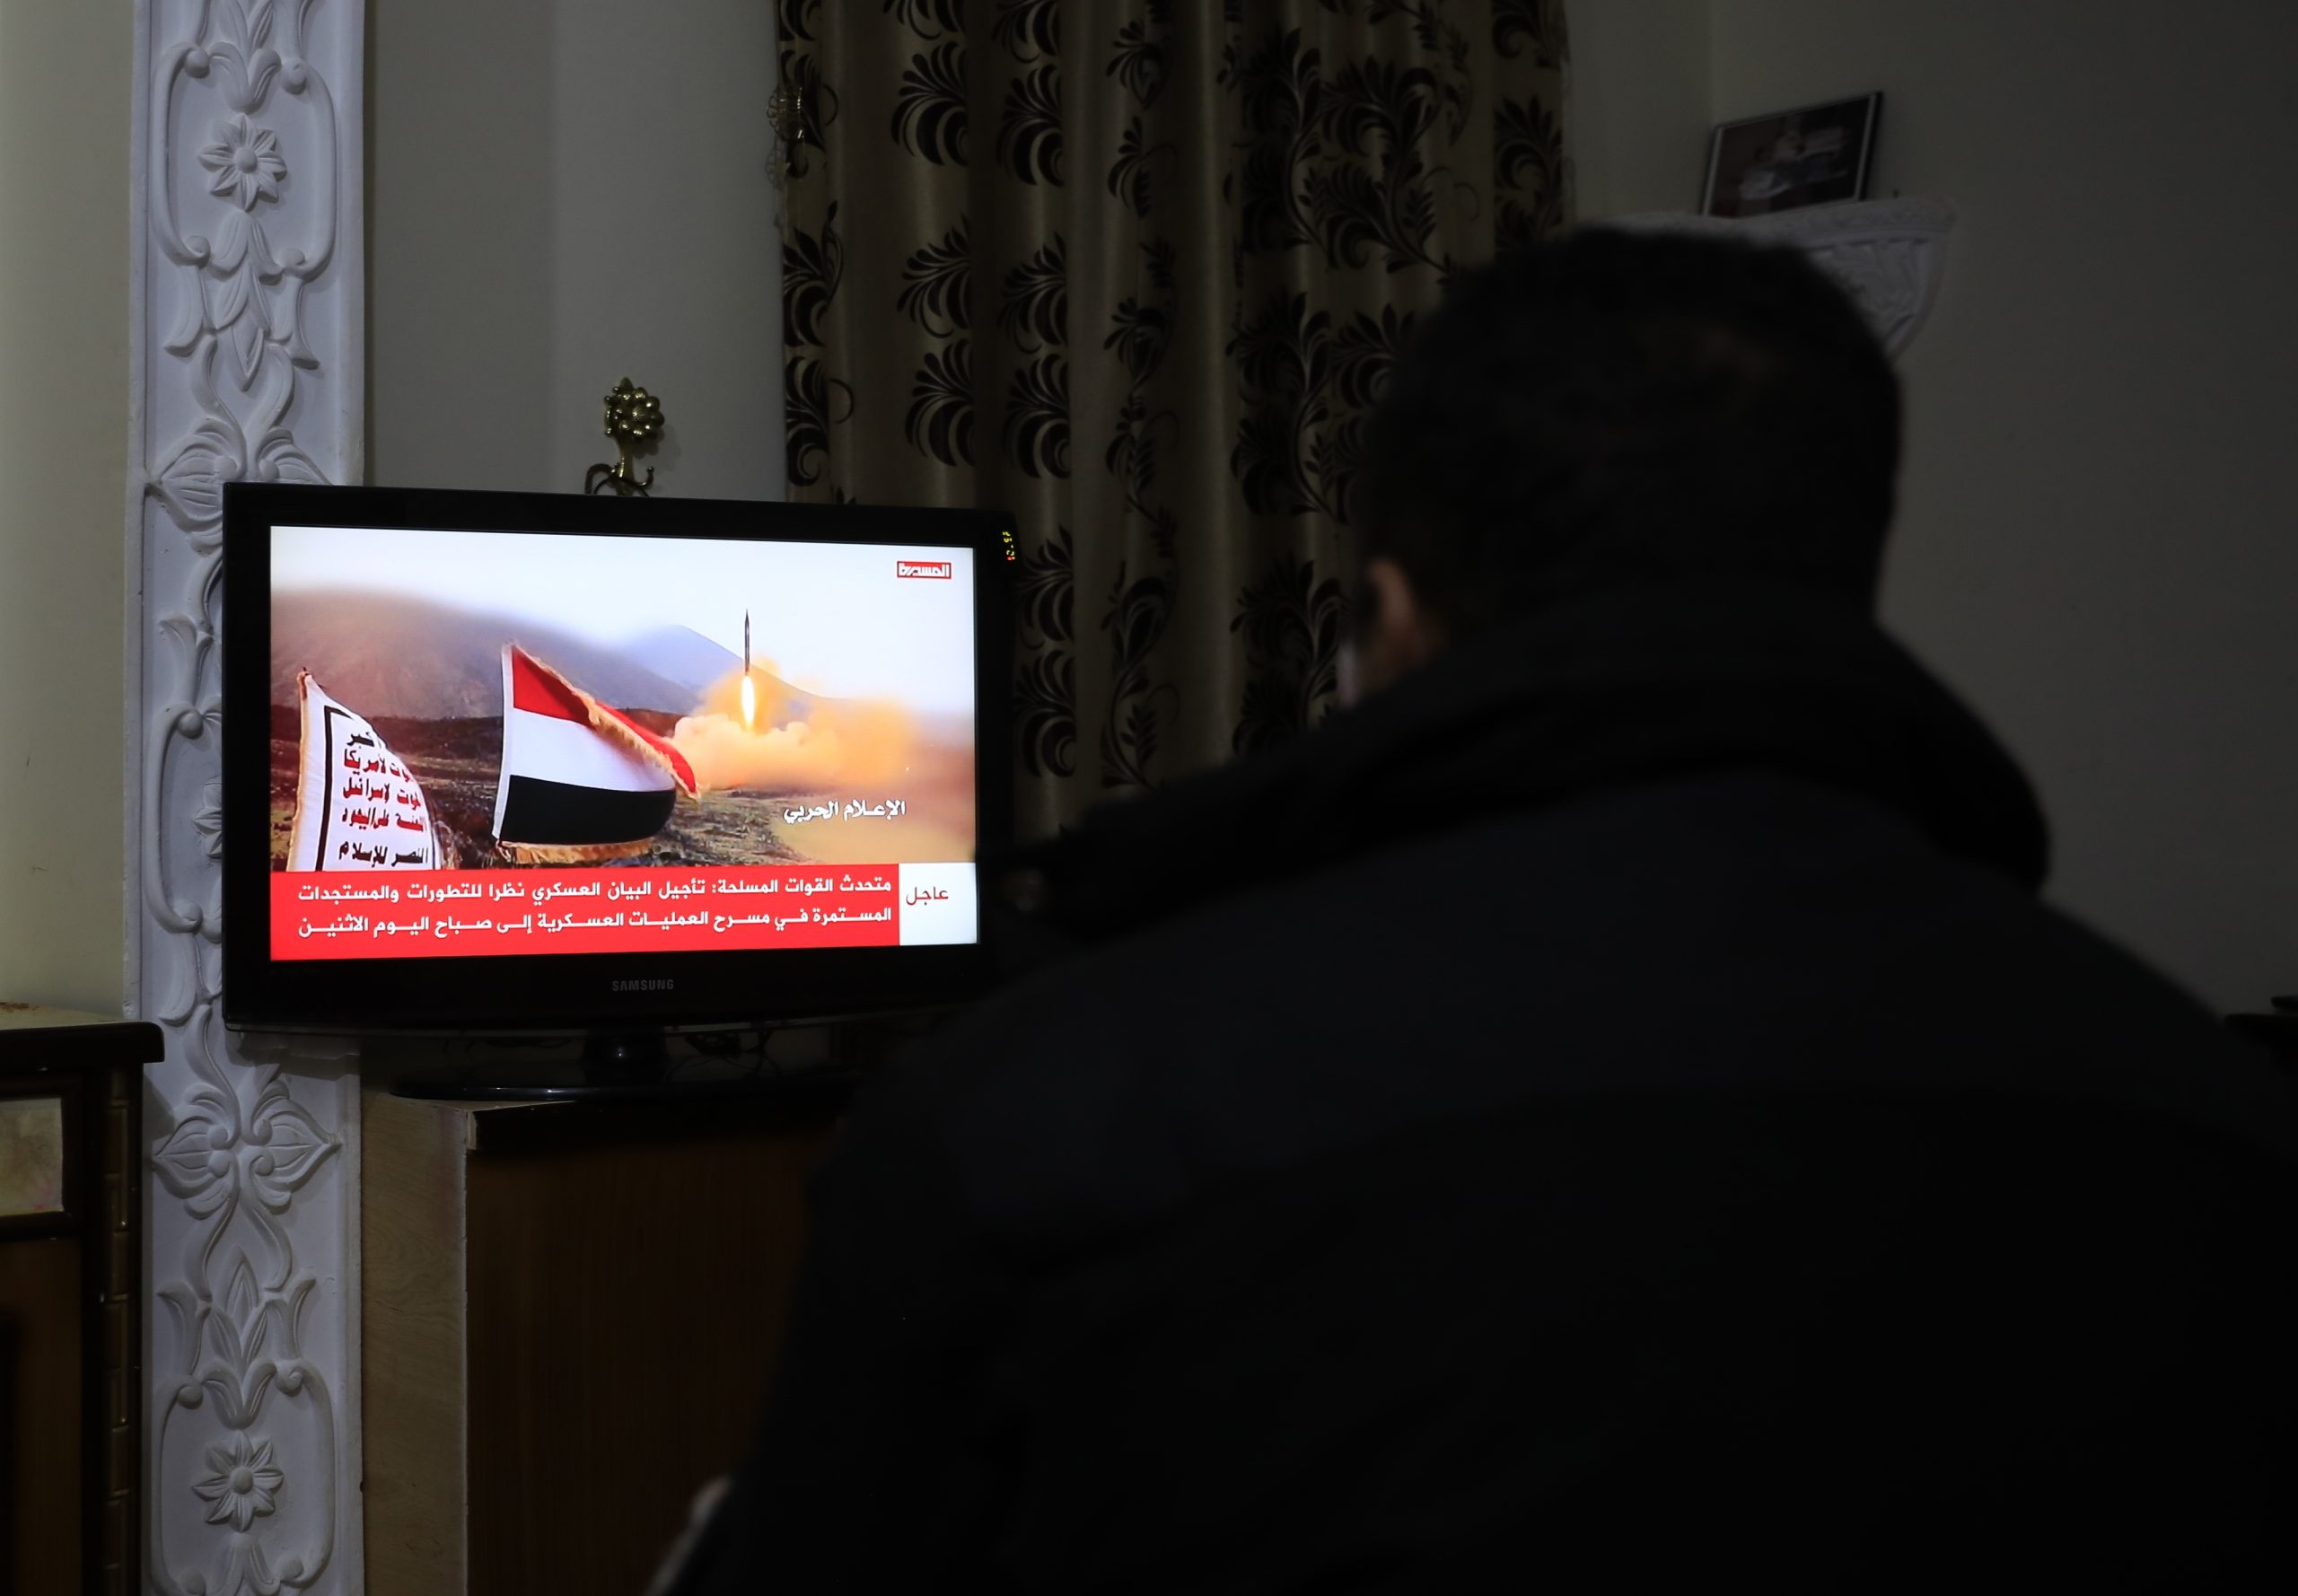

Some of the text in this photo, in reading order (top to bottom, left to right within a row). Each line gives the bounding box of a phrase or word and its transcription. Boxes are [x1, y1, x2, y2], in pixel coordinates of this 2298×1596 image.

[783, 799, 908, 825] الإعلام الحربي
[338, 841, 389, 868] للإسلام
[297, 874, 892, 906] متحدث القوات المسلحة: تأجيل البيان العسكري نظرا للتطورات والمستجدات
[905, 885, 950, 906] عاجل
[297, 907, 891, 939] المستمرة في مسرح العمليات العسكرية إلى صباح اليوم الاثنين
[612, 978, 674, 991] SAMSUNG
